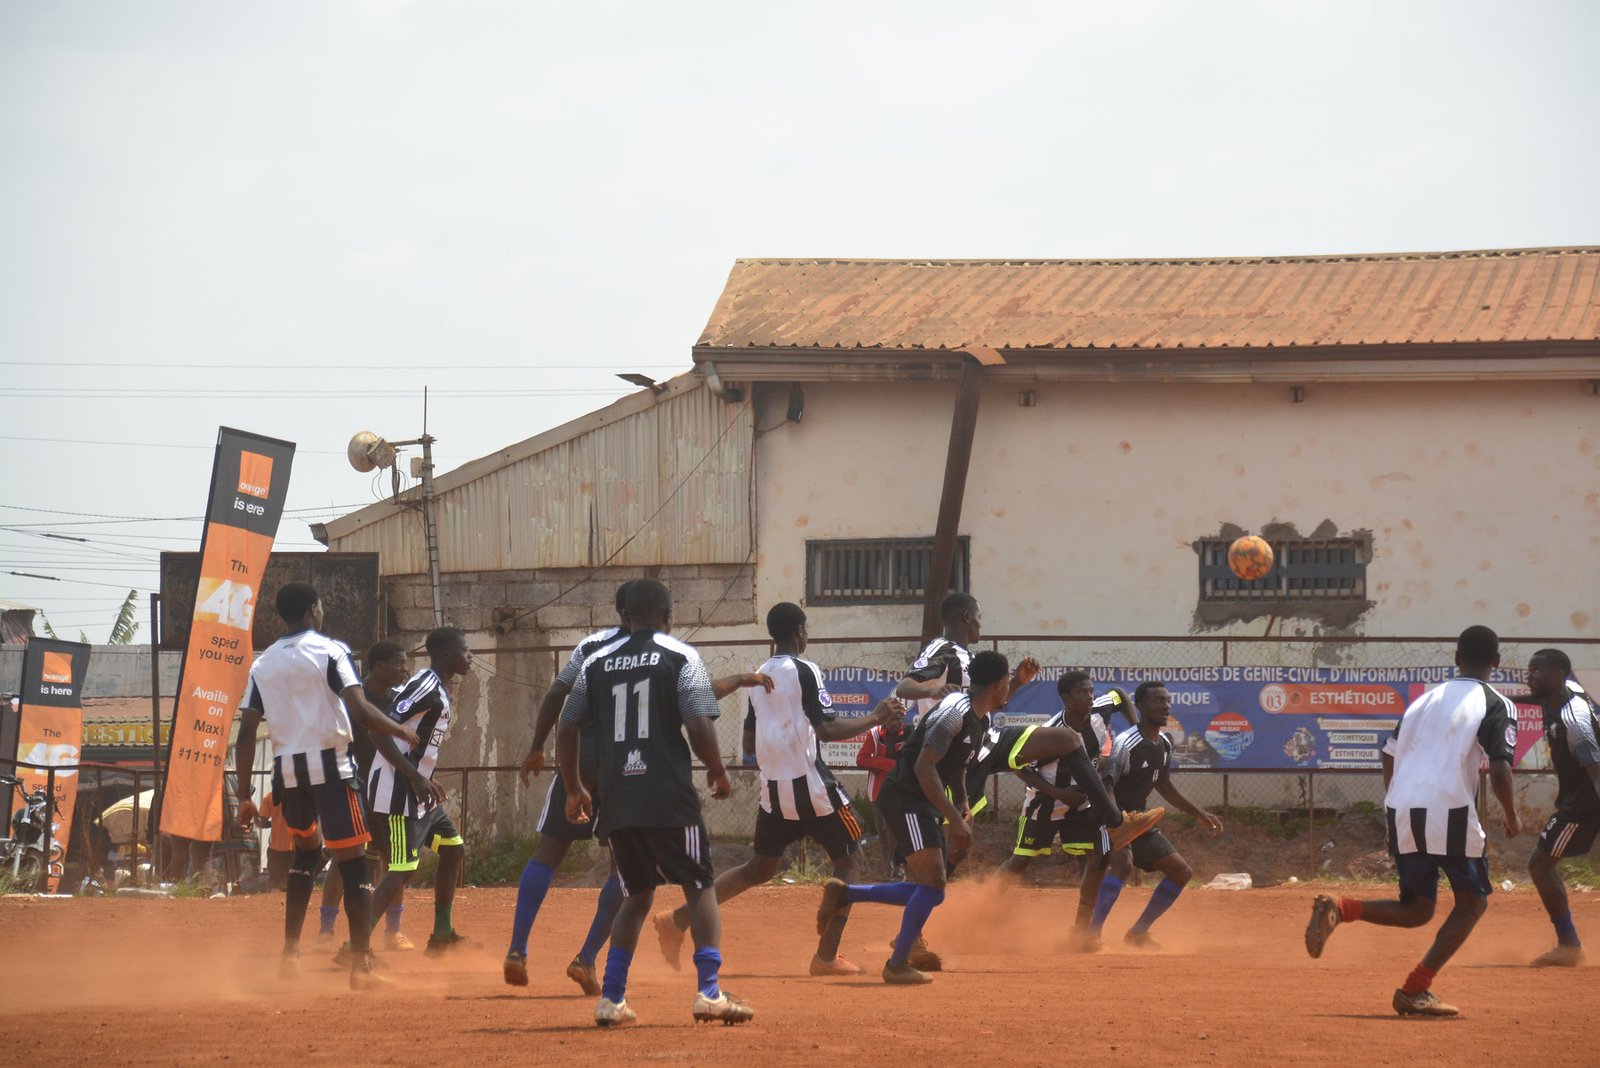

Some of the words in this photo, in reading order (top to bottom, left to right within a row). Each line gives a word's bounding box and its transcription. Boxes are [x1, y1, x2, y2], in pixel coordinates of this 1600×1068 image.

[234, 497, 245, 510] is
[245, 502, 264, 516] ere
[200, 648, 222, 661] you
[866, 669, 883, 682] DE
[1090, 667, 1115, 681] AUX
[1119, 668, 1219, 682] TECHNOLOGIES
[1222, 668, 1240, 682] DE
[40, 685, 49, 694] is
[51, 686, 72, 696] here
[1310, 690, 1396, 706] ESTHÉTIQUE
[208, 706, 223, 717] on
[611, 678, 650, 743] 11
[43, 728, 62, 738] The
[204, 738, 217, 749] or
[32, 783, 62, 792] sped
